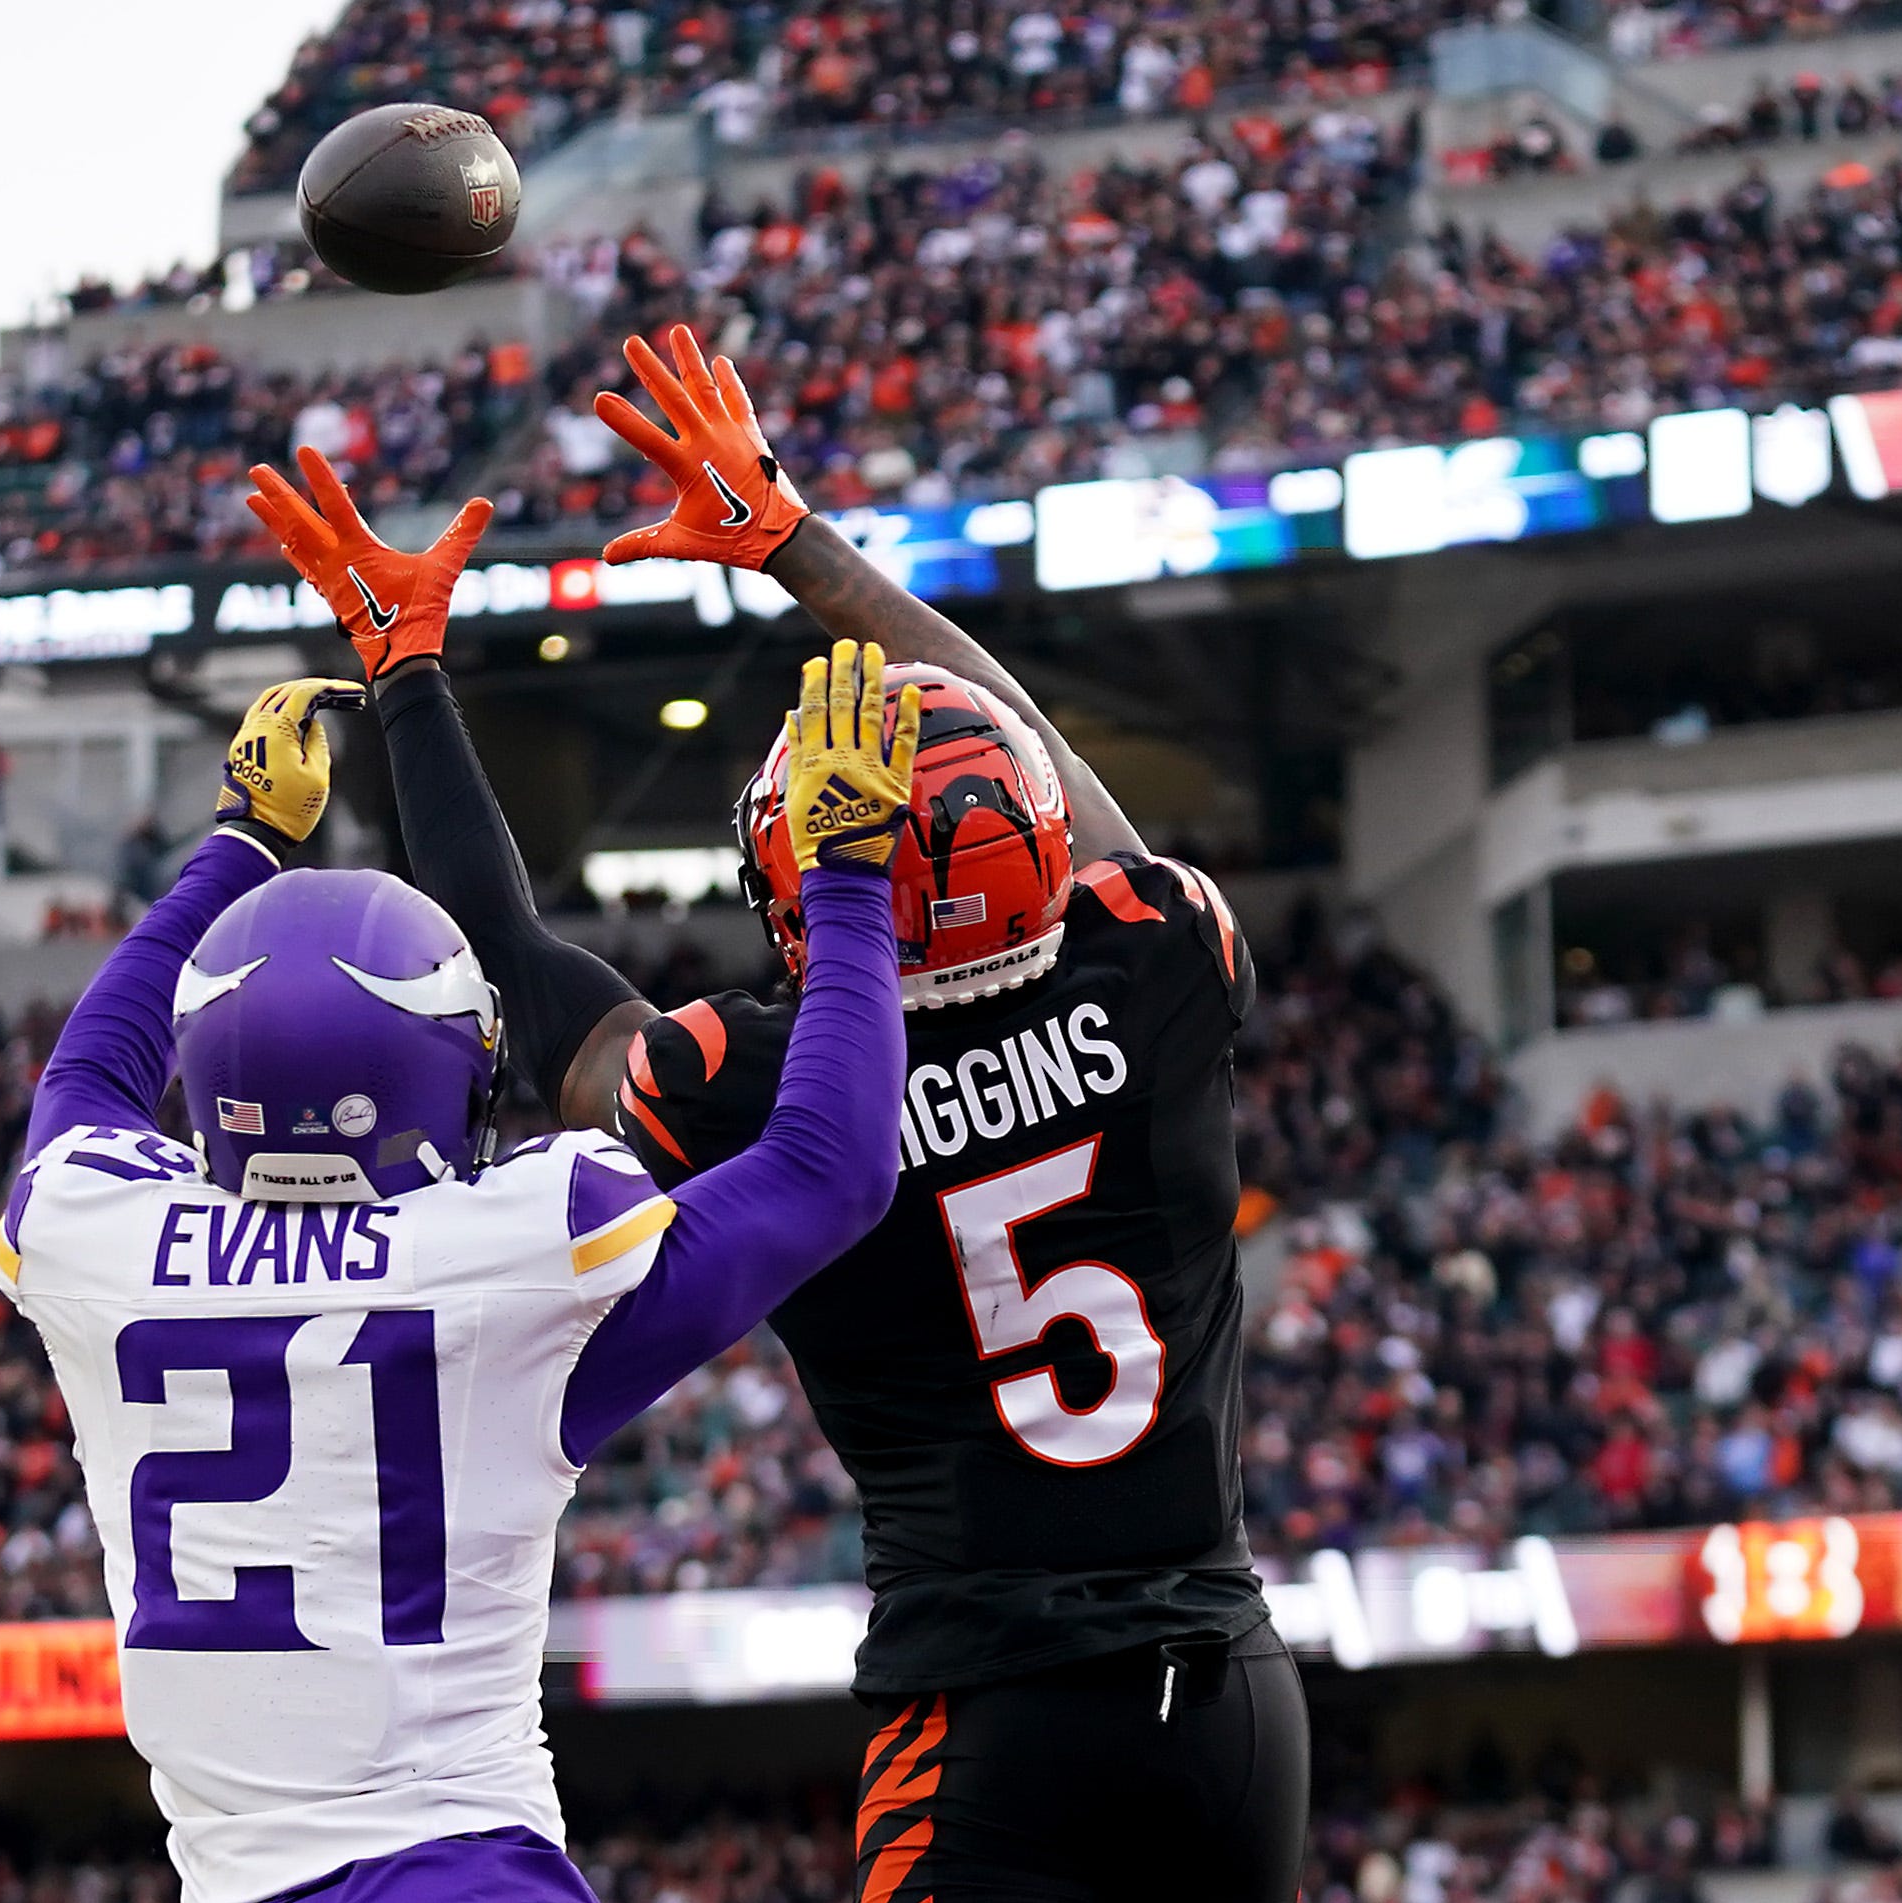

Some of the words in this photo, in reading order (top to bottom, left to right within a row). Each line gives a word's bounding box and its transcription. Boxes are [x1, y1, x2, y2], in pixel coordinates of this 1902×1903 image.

[472, 188, 501, 223] NFL
[805, 800, 882, 835] adidas
[1006, 911, 1027, 948] 5
[933, 945, 1041, 986] BENGALS
[896, 1002, 1128, 1172] IGGINS
[250, 1172, 259, 1181] IT
[262, 1173, 297, 1186] TAKES
[300, 1175, 321, 1186] ALL
[323, 1175, 339, 1185] OF
[341, 1172, 357, 1183] US
[152, 1202, 401, 1288] EVANS
[936, 1132, 1167, 1469] 5
[115, 1309, 447, 1652] 21
